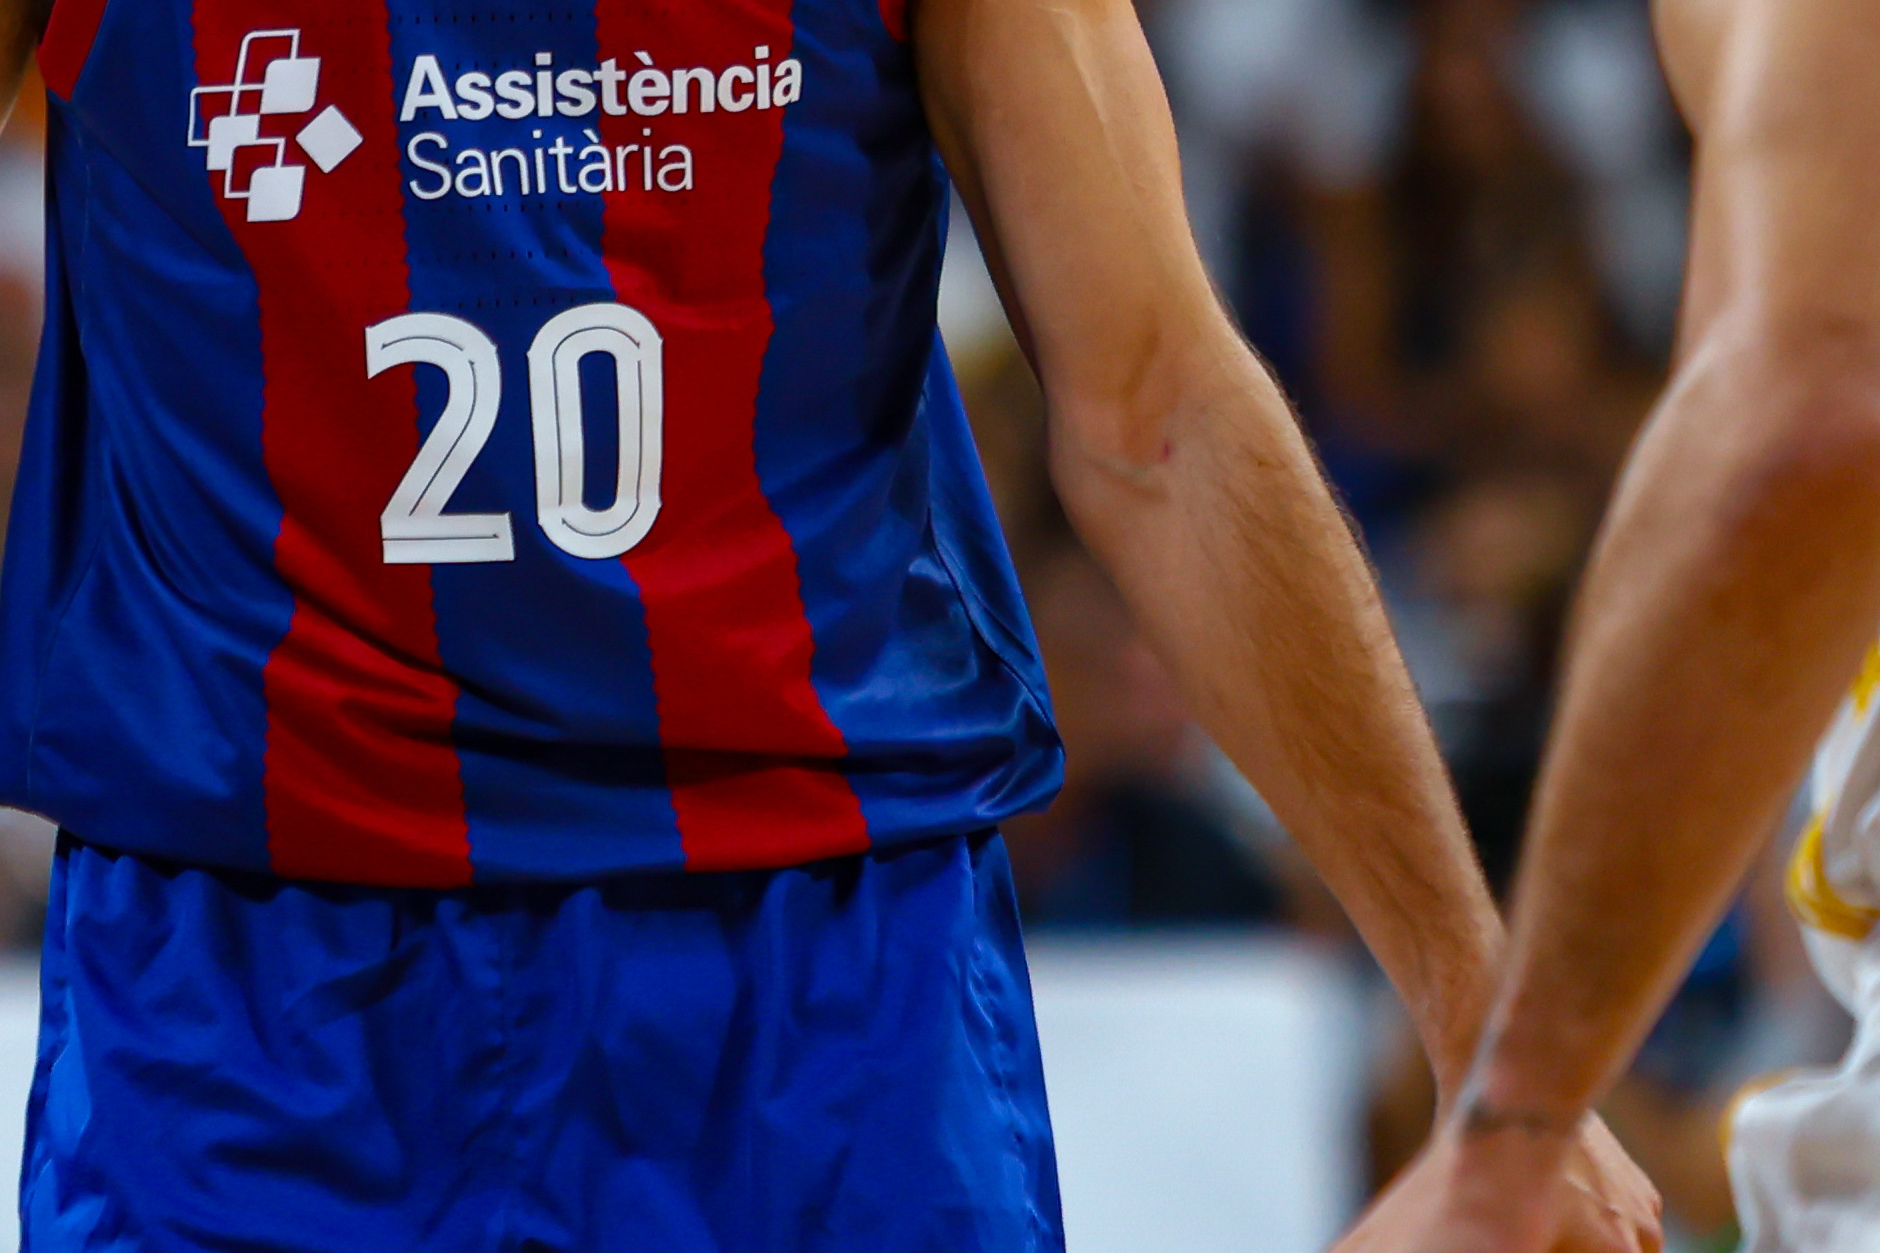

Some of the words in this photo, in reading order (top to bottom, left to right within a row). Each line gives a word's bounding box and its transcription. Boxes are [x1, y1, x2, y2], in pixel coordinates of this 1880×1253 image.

[399, 45, 803, 122] Assistència
[406, 128, 695, 201] Sanitària
[364, 300, 665, 565] 20
